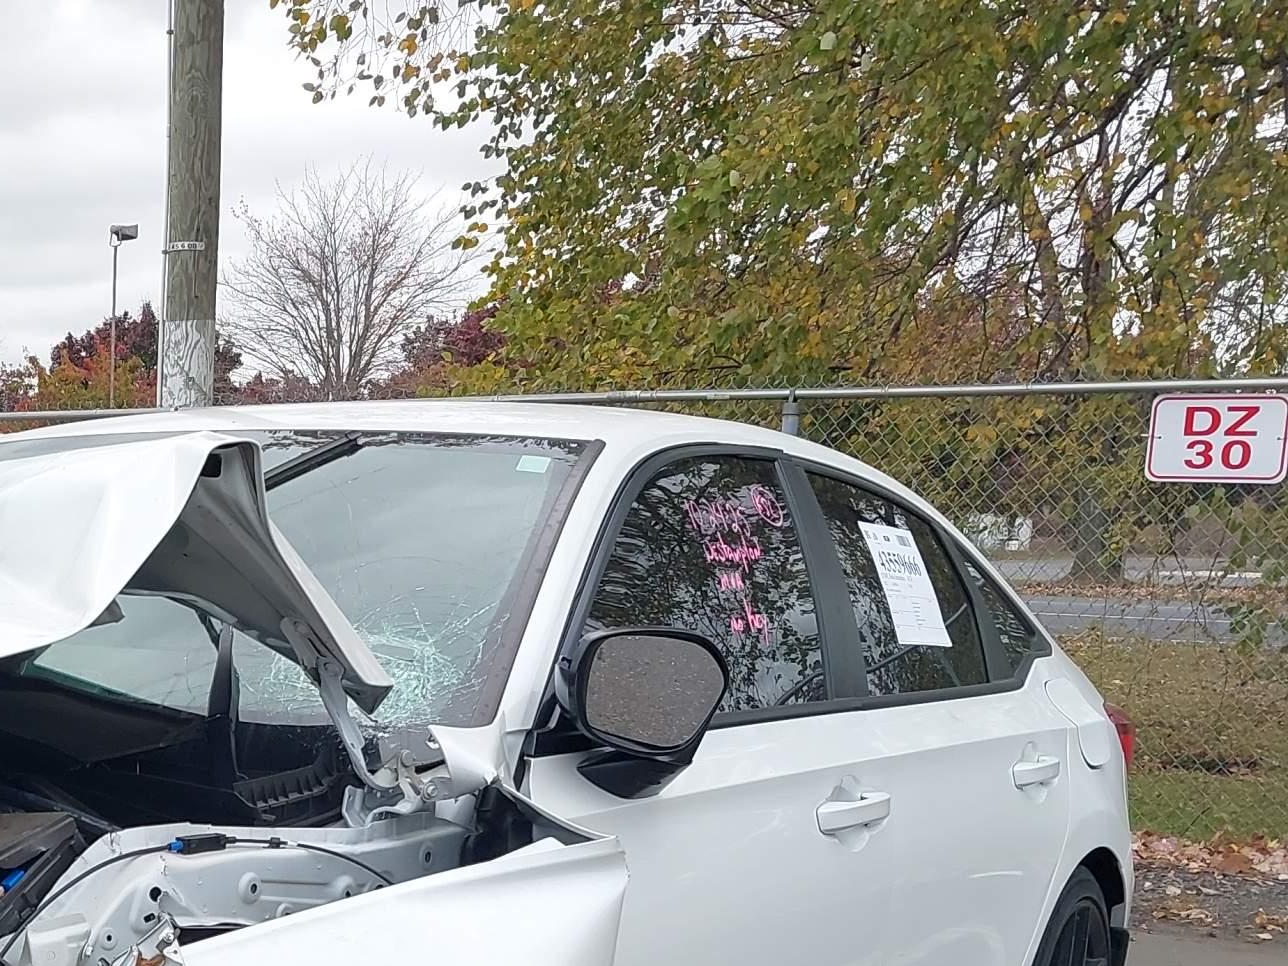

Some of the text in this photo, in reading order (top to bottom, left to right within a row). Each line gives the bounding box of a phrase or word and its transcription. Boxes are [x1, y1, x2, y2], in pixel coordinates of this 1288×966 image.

[1184, 406, 1261, 437] DZ
[1184, 440, 1252, 469] 30
[877, 550, 922, 577] 43559666
